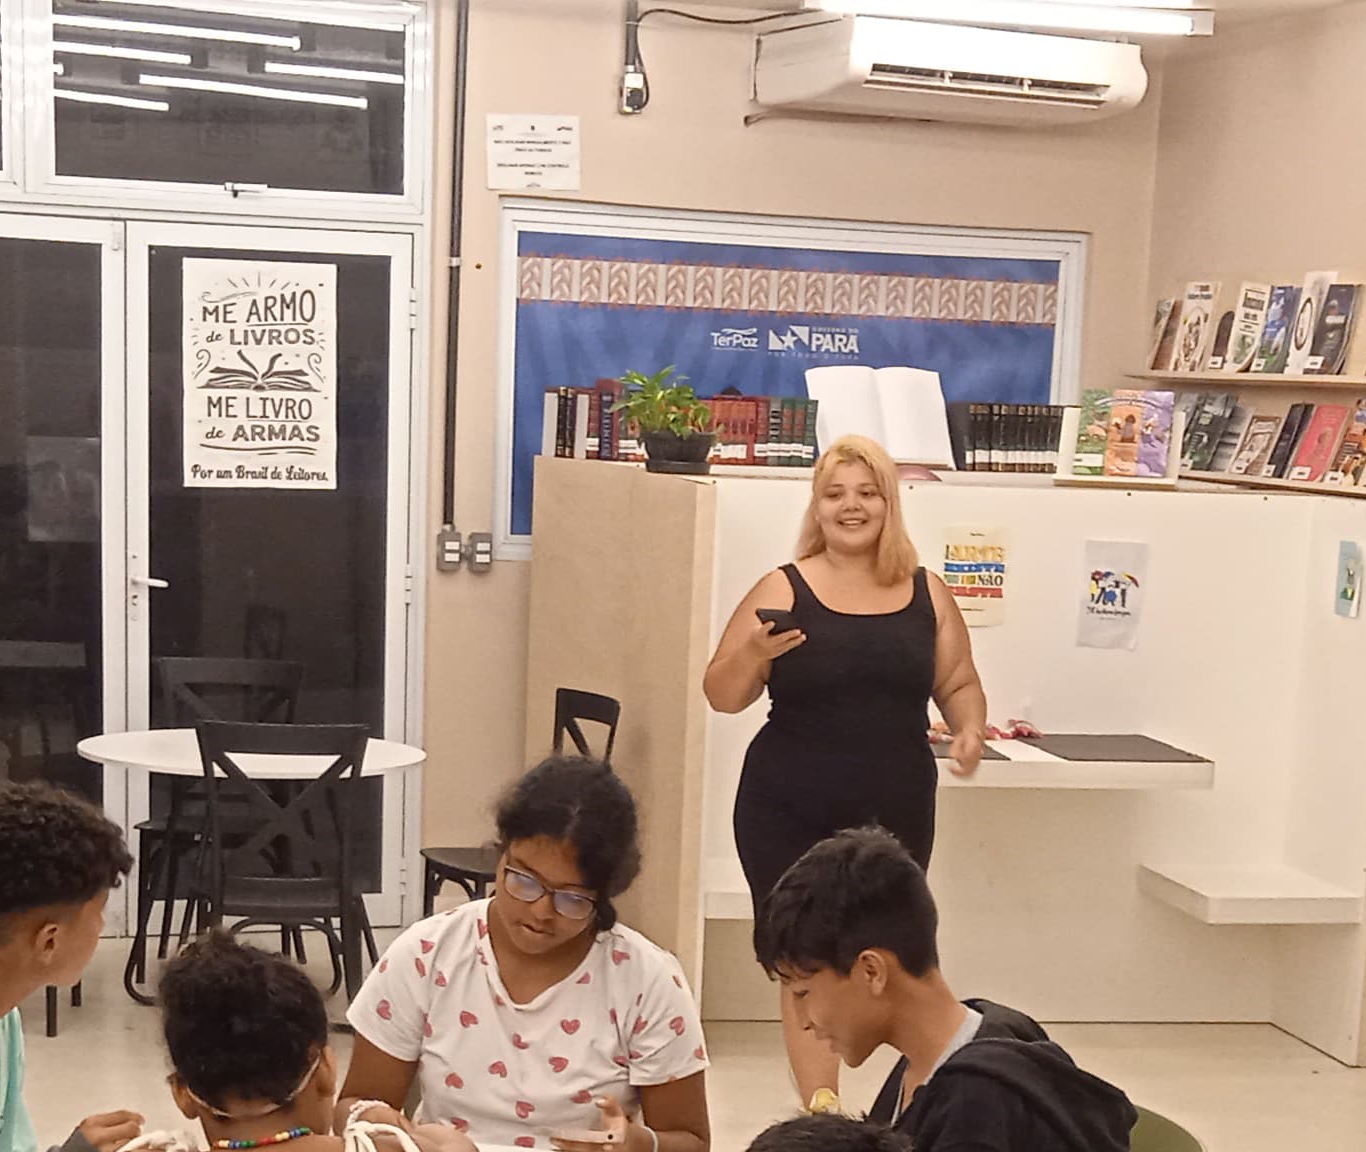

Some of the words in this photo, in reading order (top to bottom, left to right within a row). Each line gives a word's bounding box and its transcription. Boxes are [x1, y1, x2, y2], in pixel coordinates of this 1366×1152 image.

[202, 302, 237, 323] ME
[246, 289, 316, 323] ARMO
[206, 331, 223, 343] de
[229, 328, 316, 346] LIVROS
[710, 332, 758, 348] TerPaz
[207, 396, 237, 418] ME
[245, 397, 313, 420] LIVRO
[205, 427, 224, 440] de
[232, 424, 321, 443] ARMAS
[191, 464, 214, 479] Por
[216, 469, 233, 479] um
[235, 465, 268, 480] Brasil
[270, 466, 283, 480] de
